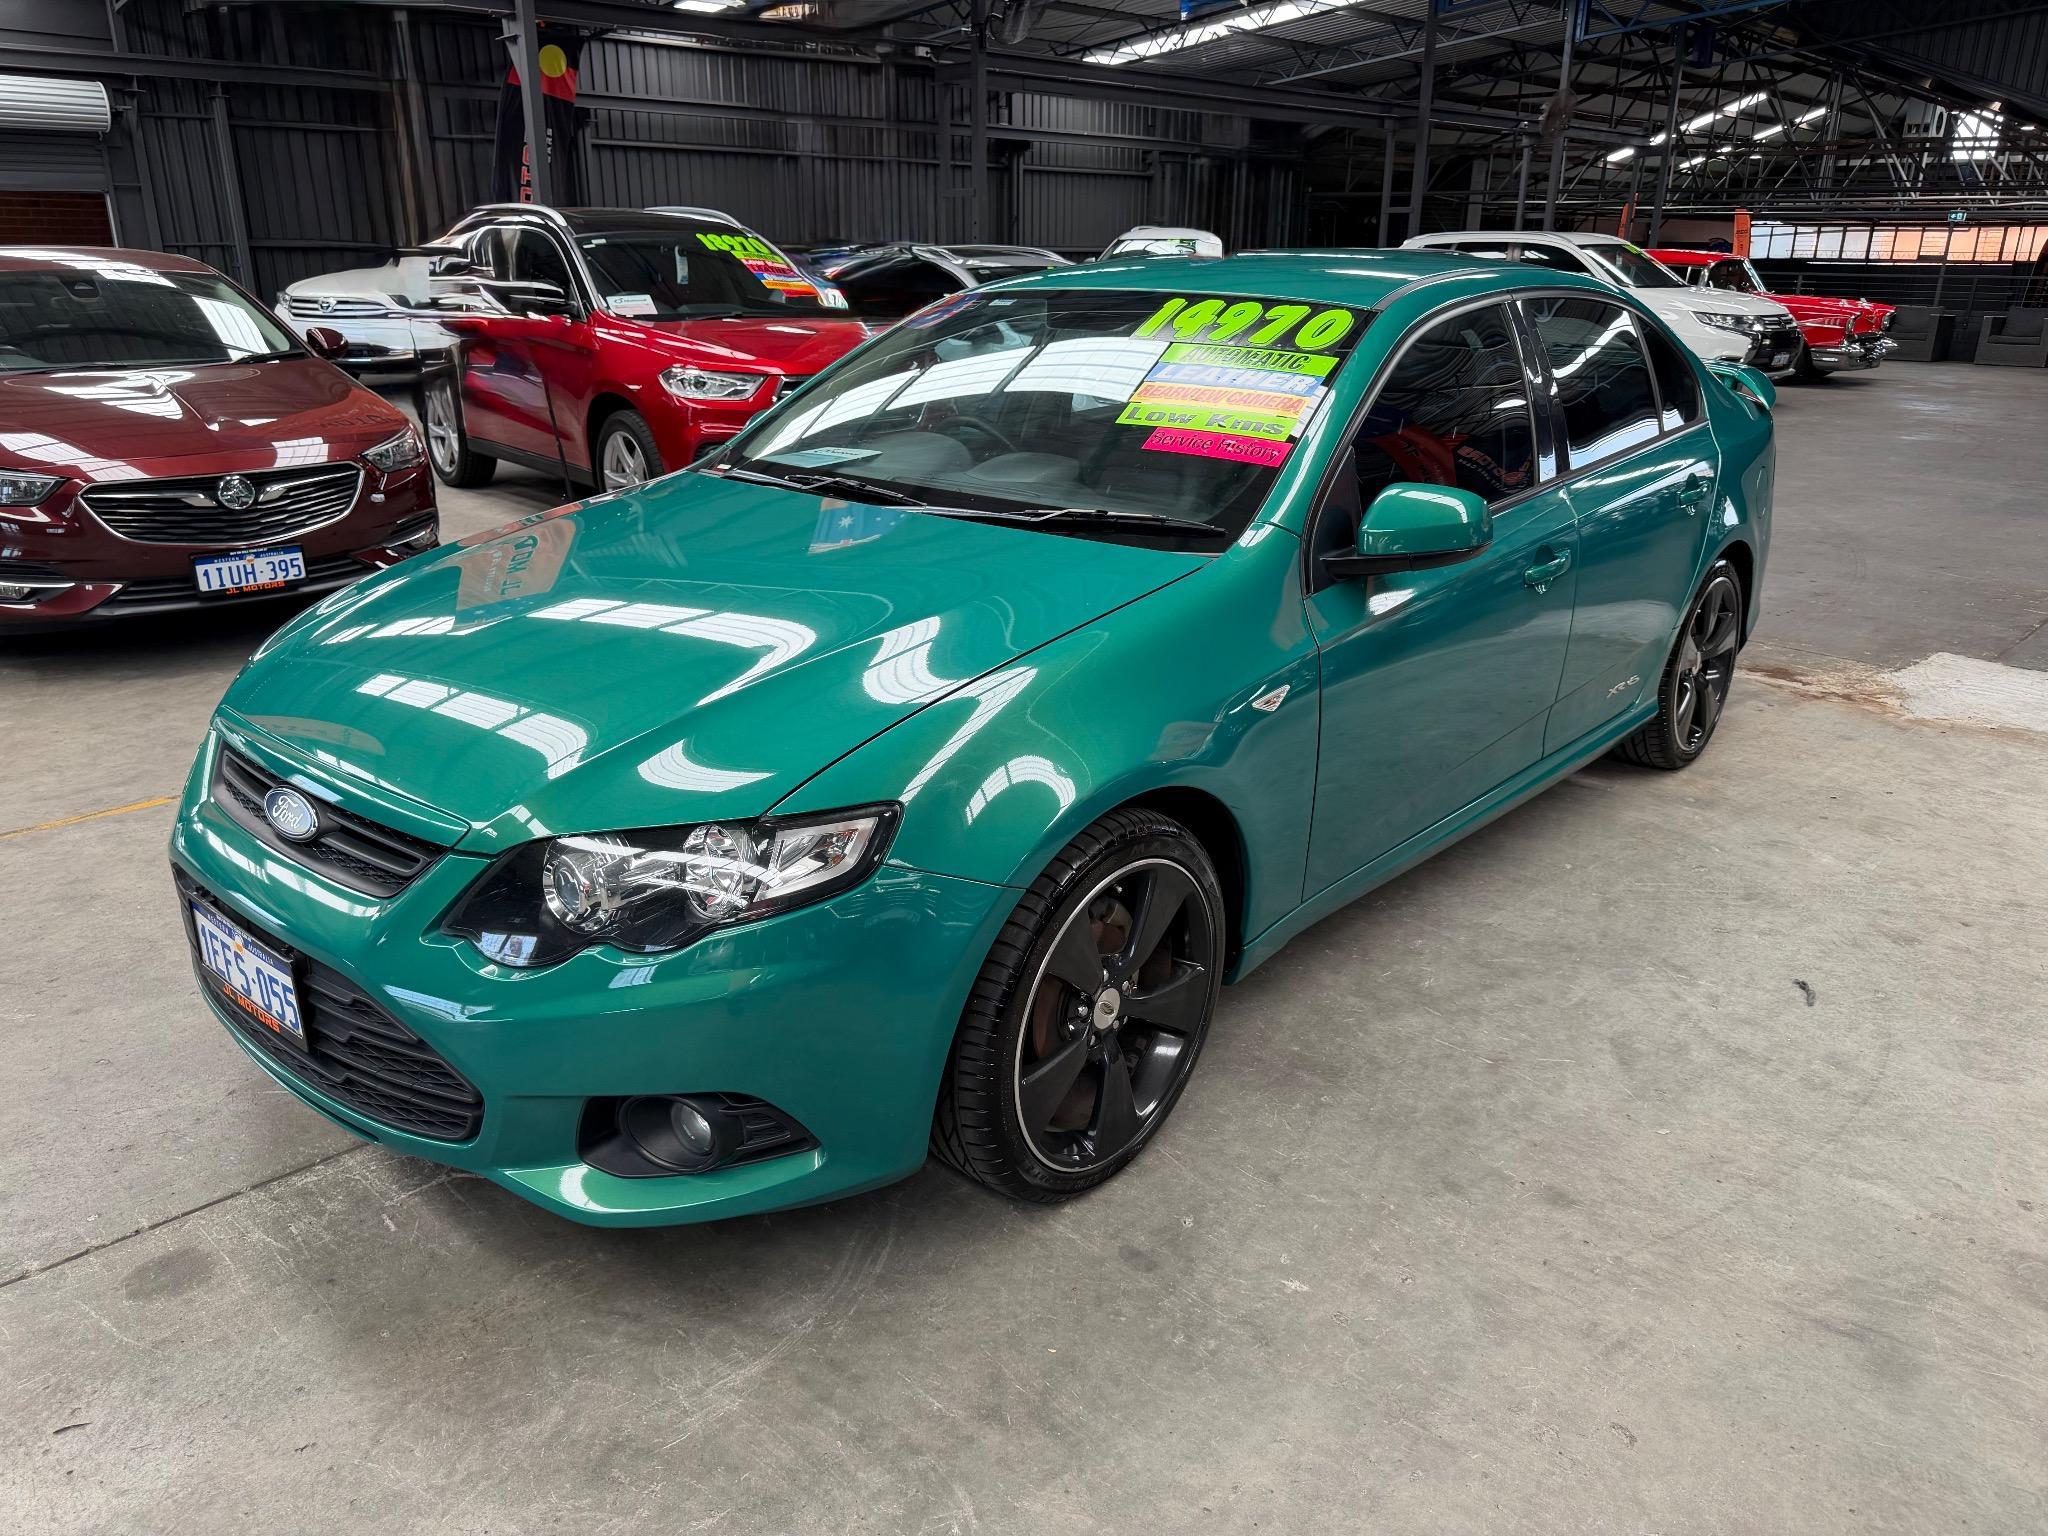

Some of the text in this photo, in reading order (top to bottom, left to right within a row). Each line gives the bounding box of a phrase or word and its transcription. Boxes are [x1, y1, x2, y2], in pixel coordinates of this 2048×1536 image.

[695, 233, 770, 255] 18970
[1135, 298, 1355, 351] 14970
[1180, 346, 1312, 371] AUTOMATIC
[1153, 363, 1317, 395] LEATHER
[1137, 384, 1307, 415] REARVIEW CAMERA
[1125, 407, 1287, 436] Low Kms
[1151, 430, 1282, 462] Service History
[226, 581, 286, 595] JL MOTORS
[272, 795, 304, 829] Ford
[223, 982, 282, 1034] JL MOTORS
